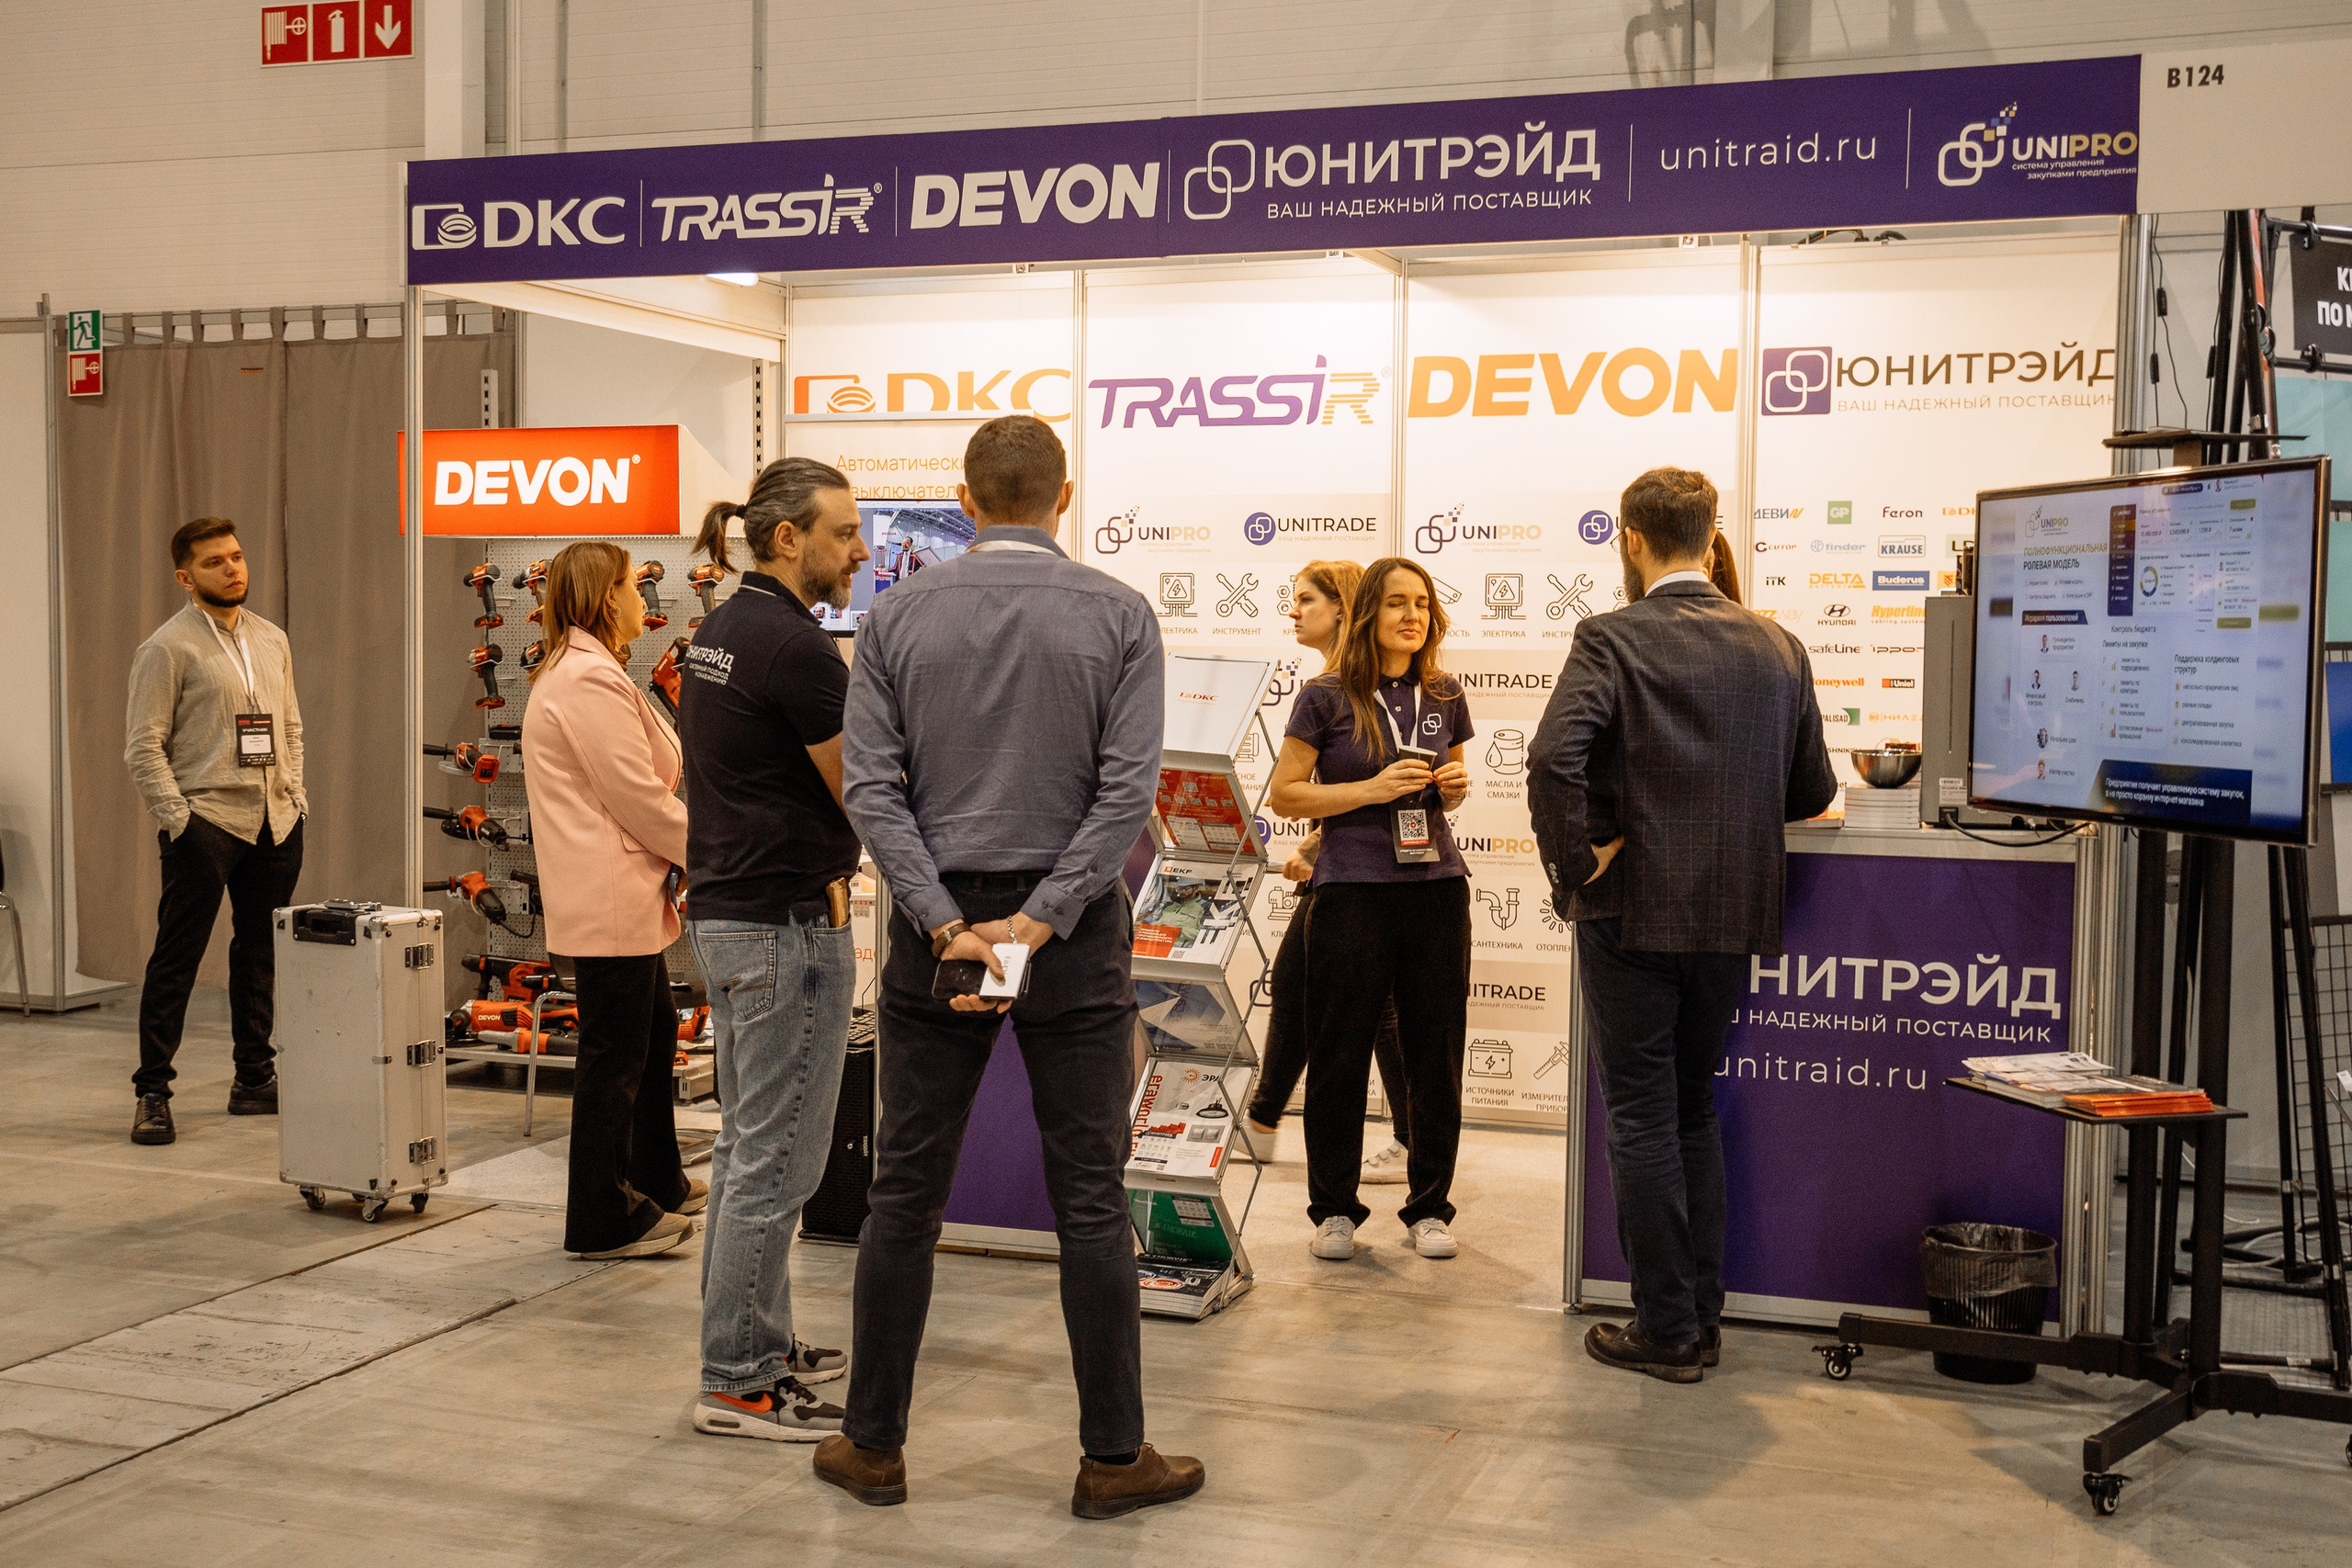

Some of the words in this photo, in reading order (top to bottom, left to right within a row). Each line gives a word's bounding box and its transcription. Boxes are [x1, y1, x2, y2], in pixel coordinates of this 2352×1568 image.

[2166, 63, 2224, 89] B124
[1660, 132, 1877, 172] unitraid.ru
[2012, 131, 2138, 161] UNIPRO
[1265, 121, 1601, 188] ЮНИТРЭЙД
[2011, 163, 2049, 171] система
[2049, 159, 2105, 170] управления
[2027, 170, 2075, 180] закупками
[2076, 167, 2137, 178] предприятия
[910, 163, 1159, 230] DEVON
[1268, 203, 1312, 219] ВАШ
[1321, 193, 1445, 219] НАДЕЖНЫЙ
[1453, 189, 1592, 211] ПОСТАВЩИК
[484, 197, 626, 248] DKC
[2337, 266, 2352, 292] К
[2317, 300, 2343, 327] ПО
[1407, 347, 1738, 418] DEVON
[1838, 400, 1876, 412] ВАШ
[1884, 395, 1991, 412] НАДЕЖНЫЙ
[435, 457, 630, 507] DEVON
[851, 485, 956, 499] выключател
[1830, 507, 1849, 518] GP
[1278, 517, 1376, 532] UNITRADE
[2041, 518, 2069, 529] UNIPRO
[1138, 526, 1211, 540] UNIPRO
[1463, 525, 1543, 540] UNIPRO
[1881, 544, 1923, 555] KRAUSE
[2023, 559, 2052, 570] РОЛЕВАЯ
[2052, 558, 2080, 570] МОДЕЛЬ
[1809, 573, 1864, 584] DELTA
[1877, 575, 1925, 584] Buderus
[1813, 678, 1864, 688] oneywell
[1456, 837, 1535, 853] UNIPRO
[1471, 941, 1523, 950] САНТЕХНИКА
[1469, 983, 1546, 1001] ITRADE
[1749, 953, 2062, 1020] НИТРЭЙД
[1502, 1002, 1545, 1010] ПОСТАВЩИК
[1749, 1010, 1887, 1033] НАДЕЖНЫЙ
[1897, 1018, 2051, 1043] ПОСТАВЩИК
[1465, 1087, 1515, 1096] ИСТОЧНИКИ
[1521, 1092, 1567, 1102] ИЗМЕРИТЕЛ
[1471, 1098, 1509, 1106] ПИТАНИЯ
[1535, 1104, 1567, 1112] ПРИБОР
